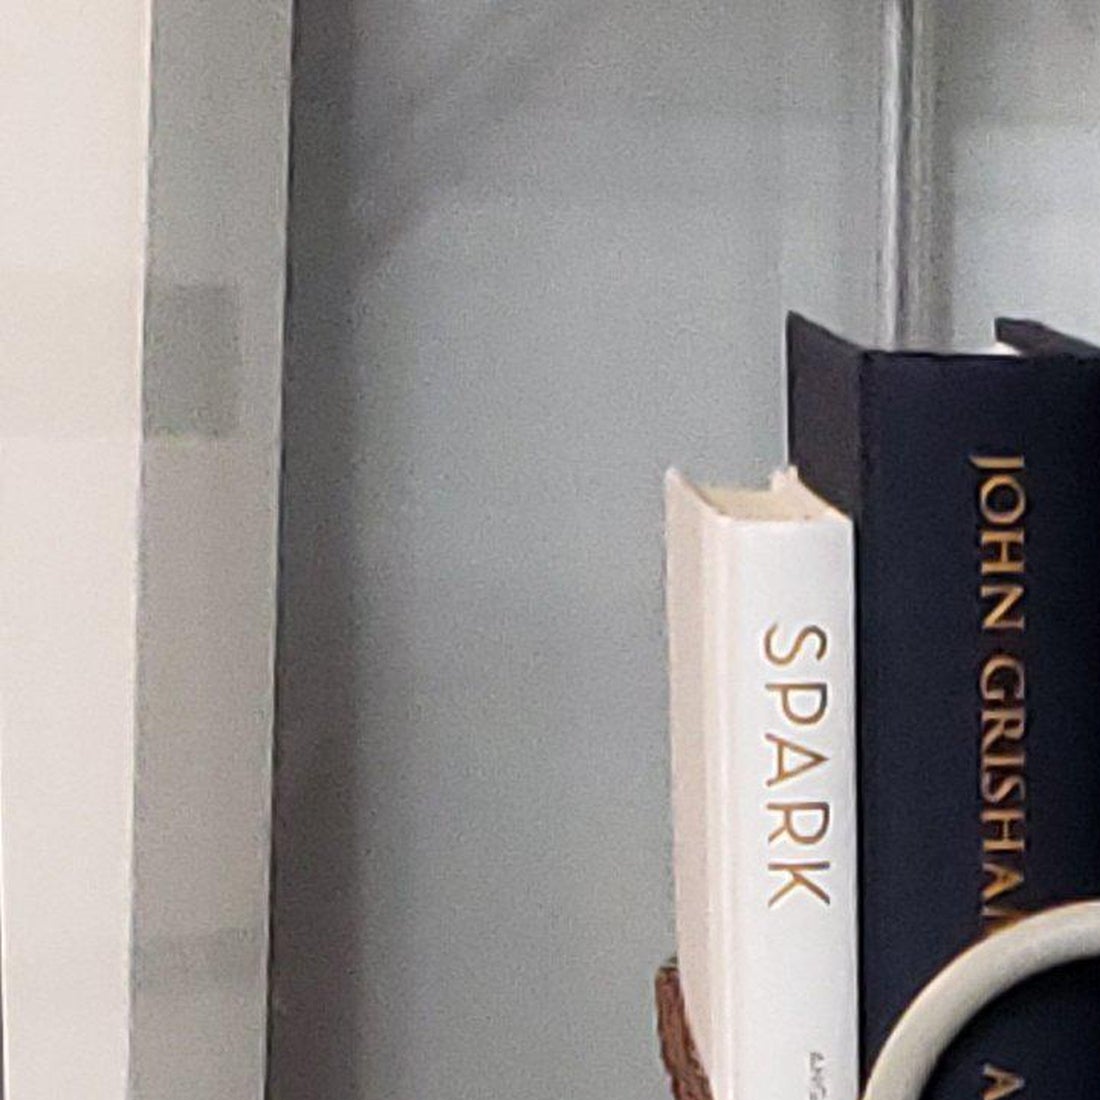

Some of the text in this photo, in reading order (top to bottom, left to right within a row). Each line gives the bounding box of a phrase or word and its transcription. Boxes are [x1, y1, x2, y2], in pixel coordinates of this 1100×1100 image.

[763, 622, 831, 908] SPARK
[969, 454, 1027, 919] JOHN GRISHA
